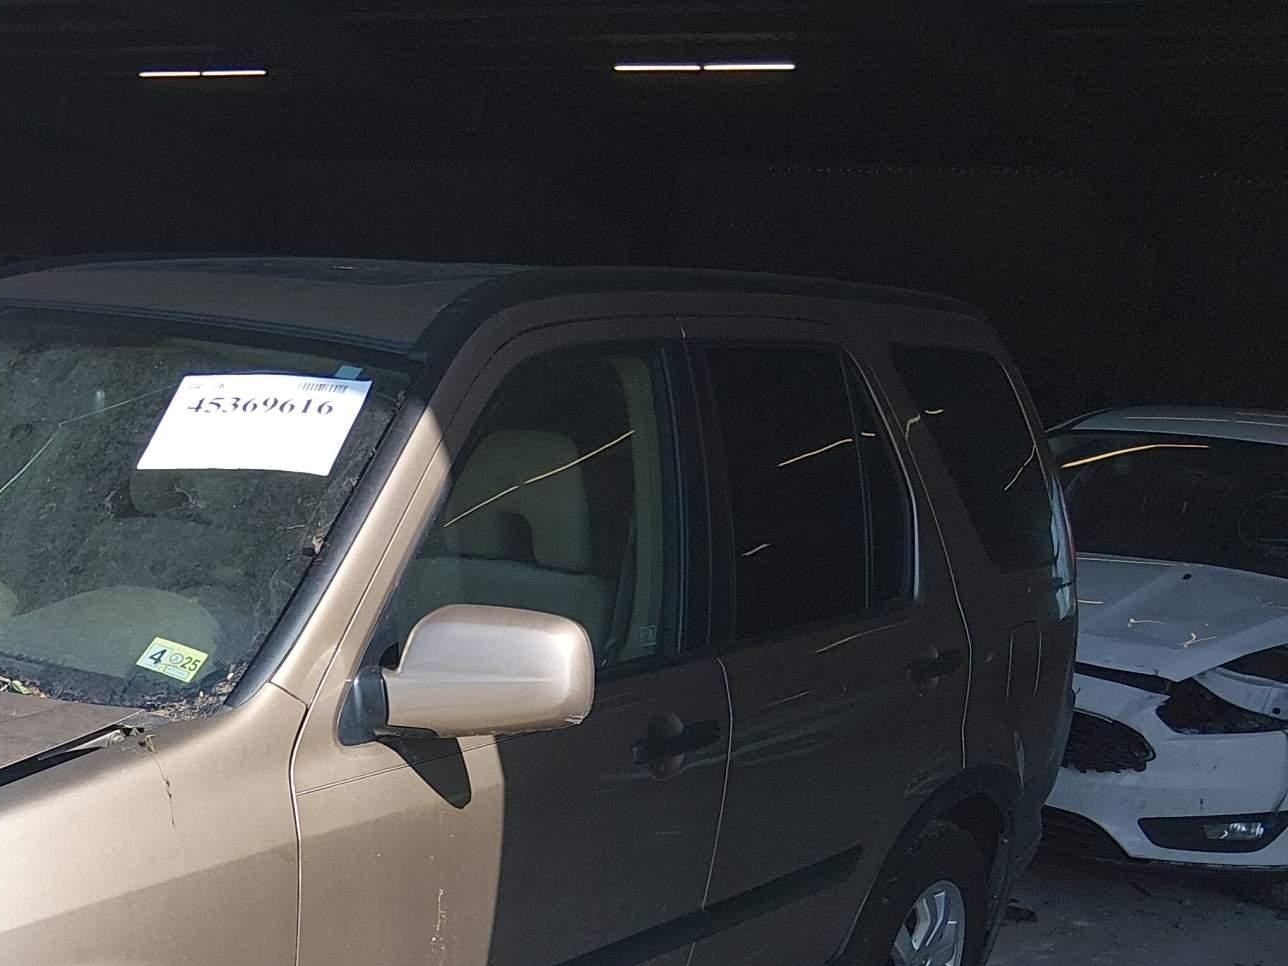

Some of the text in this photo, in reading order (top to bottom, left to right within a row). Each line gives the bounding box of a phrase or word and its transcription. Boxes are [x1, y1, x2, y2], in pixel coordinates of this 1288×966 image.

[186, 396, 336, 416] 45369616
[148, 648, 168, 665] 4
[180, 656, 201, 672] 25
